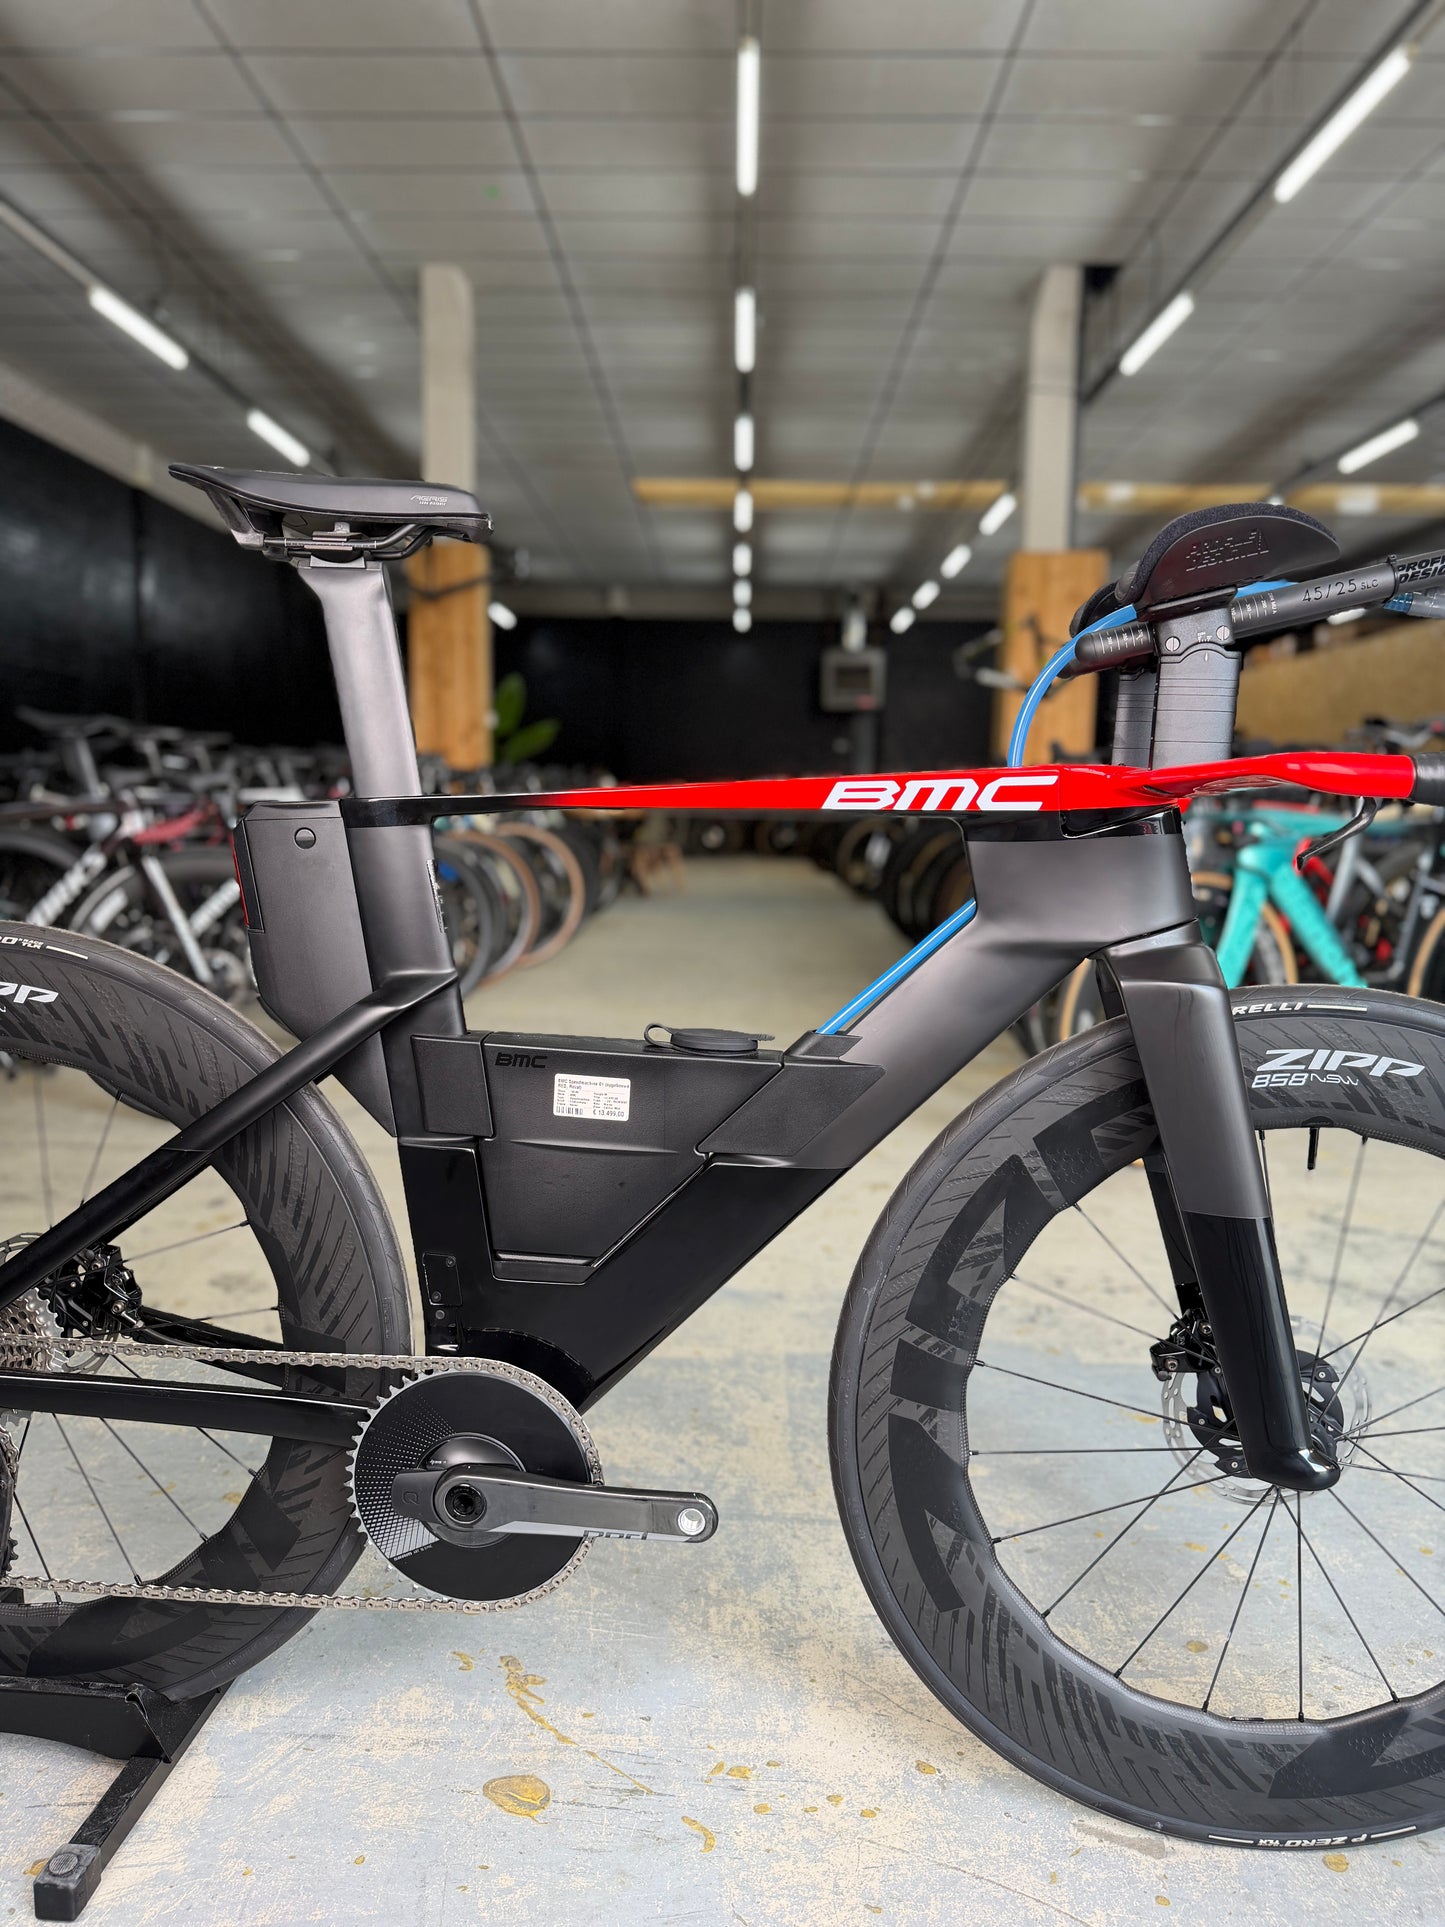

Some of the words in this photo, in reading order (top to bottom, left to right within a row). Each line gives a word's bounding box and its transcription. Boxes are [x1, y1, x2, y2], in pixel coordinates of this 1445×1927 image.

[1302, 578, 1357, 602] 45/25
[1360, 579, 1379, 590] SLC
[822, 776, 1059, 811] BMC
[494, 1052, 548, 1069] BMC
[1256, 1048, 1426, 1078] ZIPP
[1251, 1073, 1309, 1089] 858
[1284, 1836, 1348, 1848] ZERO
